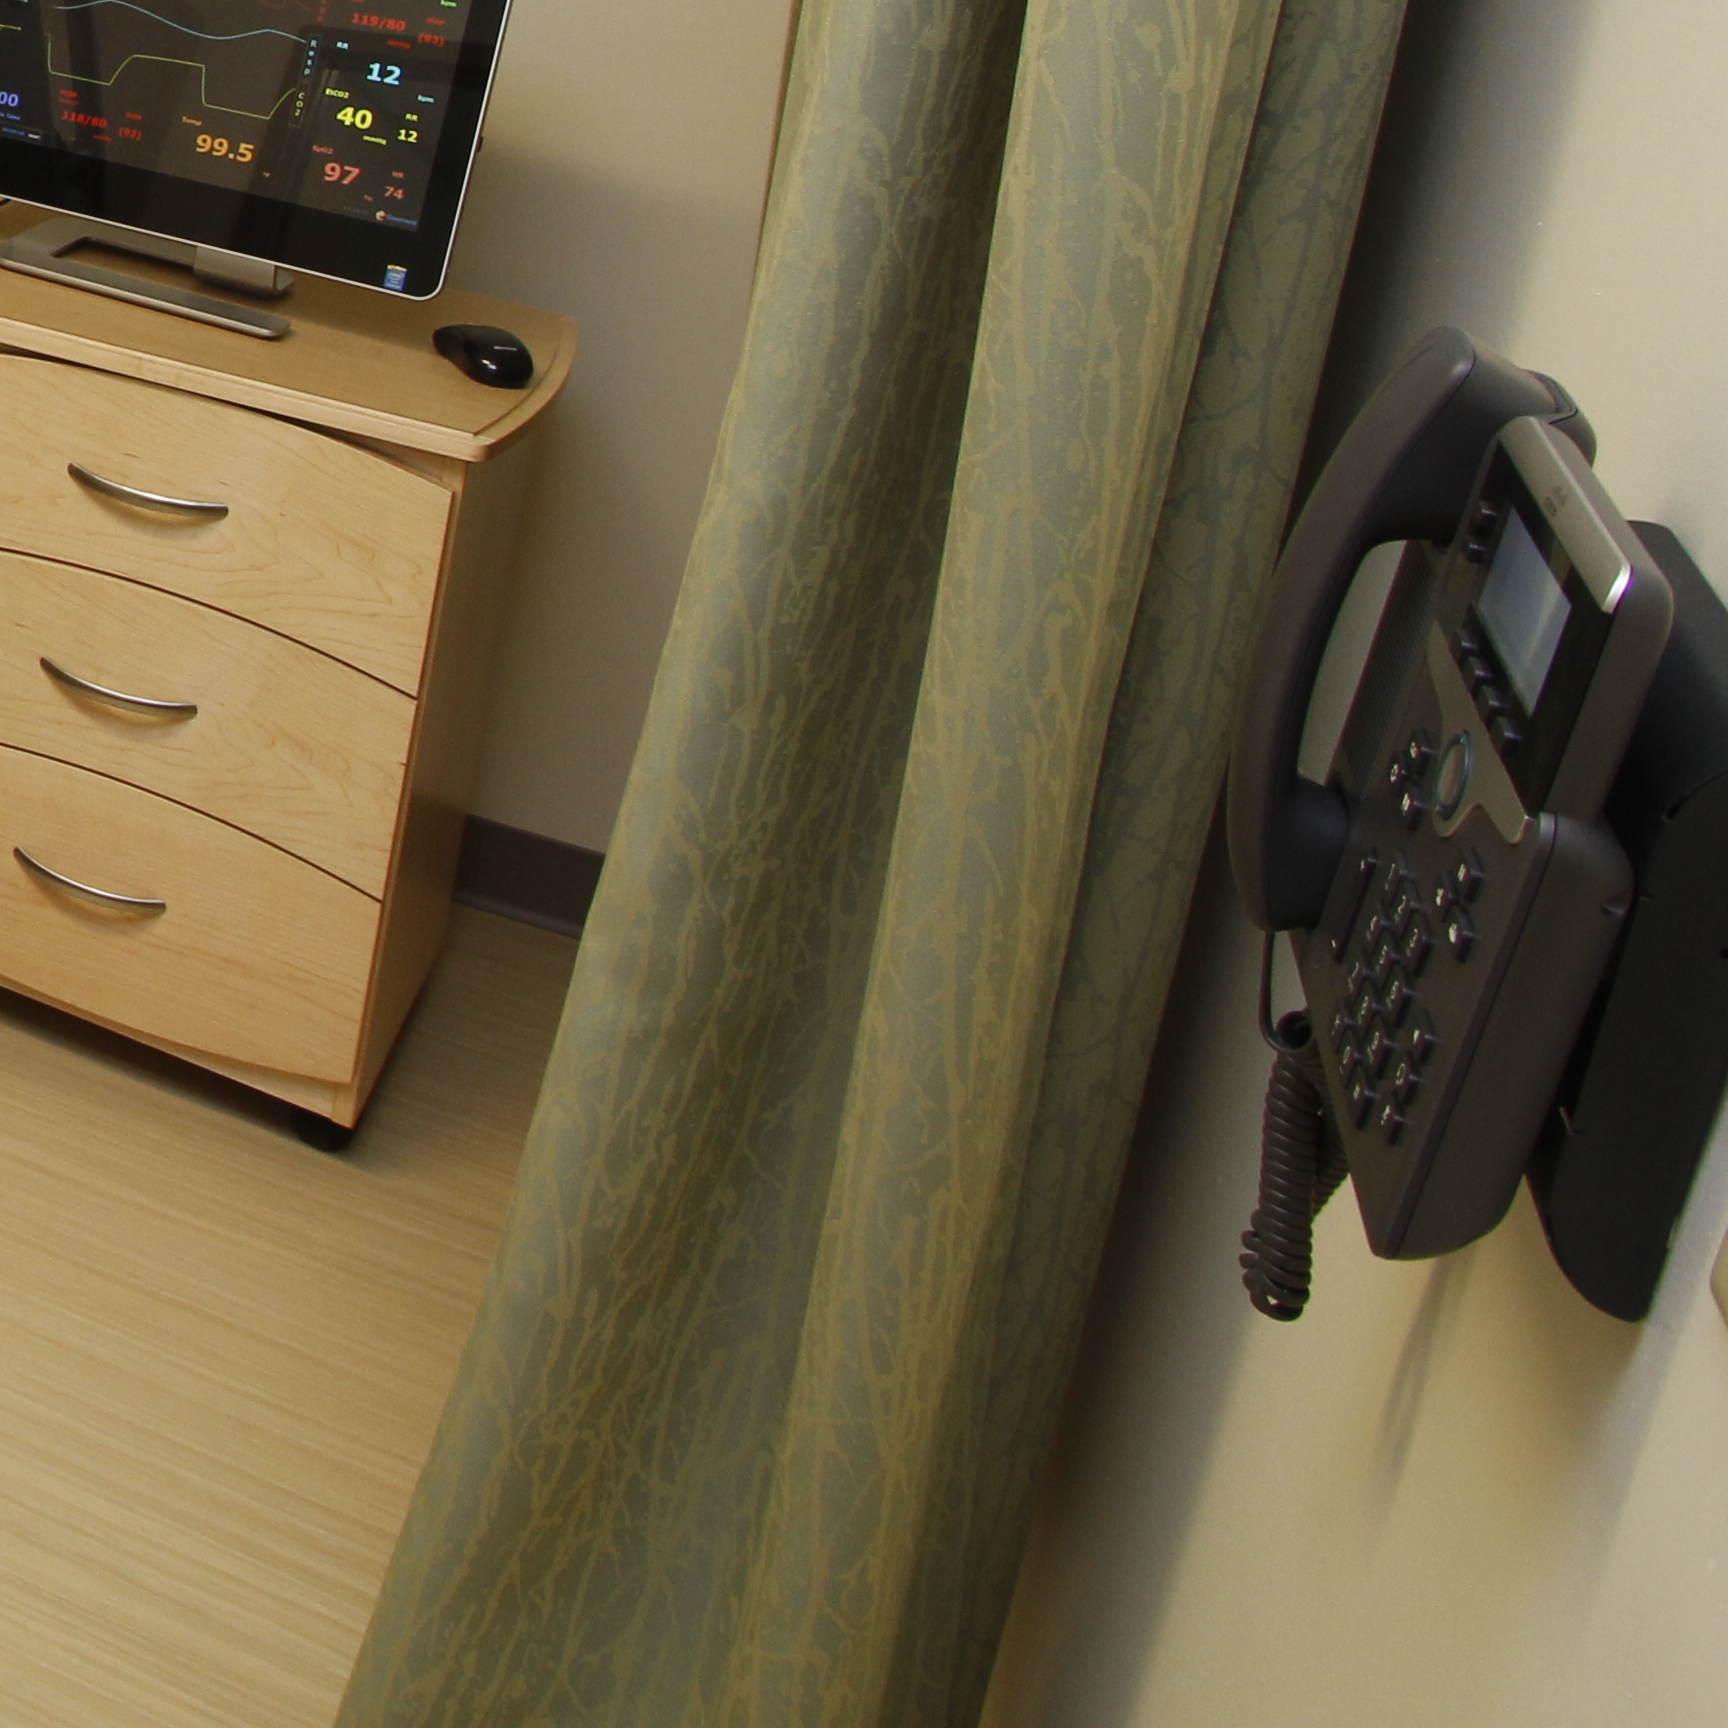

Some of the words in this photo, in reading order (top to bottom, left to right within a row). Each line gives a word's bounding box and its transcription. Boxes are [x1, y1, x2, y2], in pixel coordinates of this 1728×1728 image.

[336, 41, 350, 50] RR
[366, 62, 401, 86] 12
[336, 106, 373, 131] 40
[195, 133, 255, 163] 99.5
[397, 129, 419, 143] 12
[323, 161, 361, 186] 97
[384, 185, 405, 200] 74
